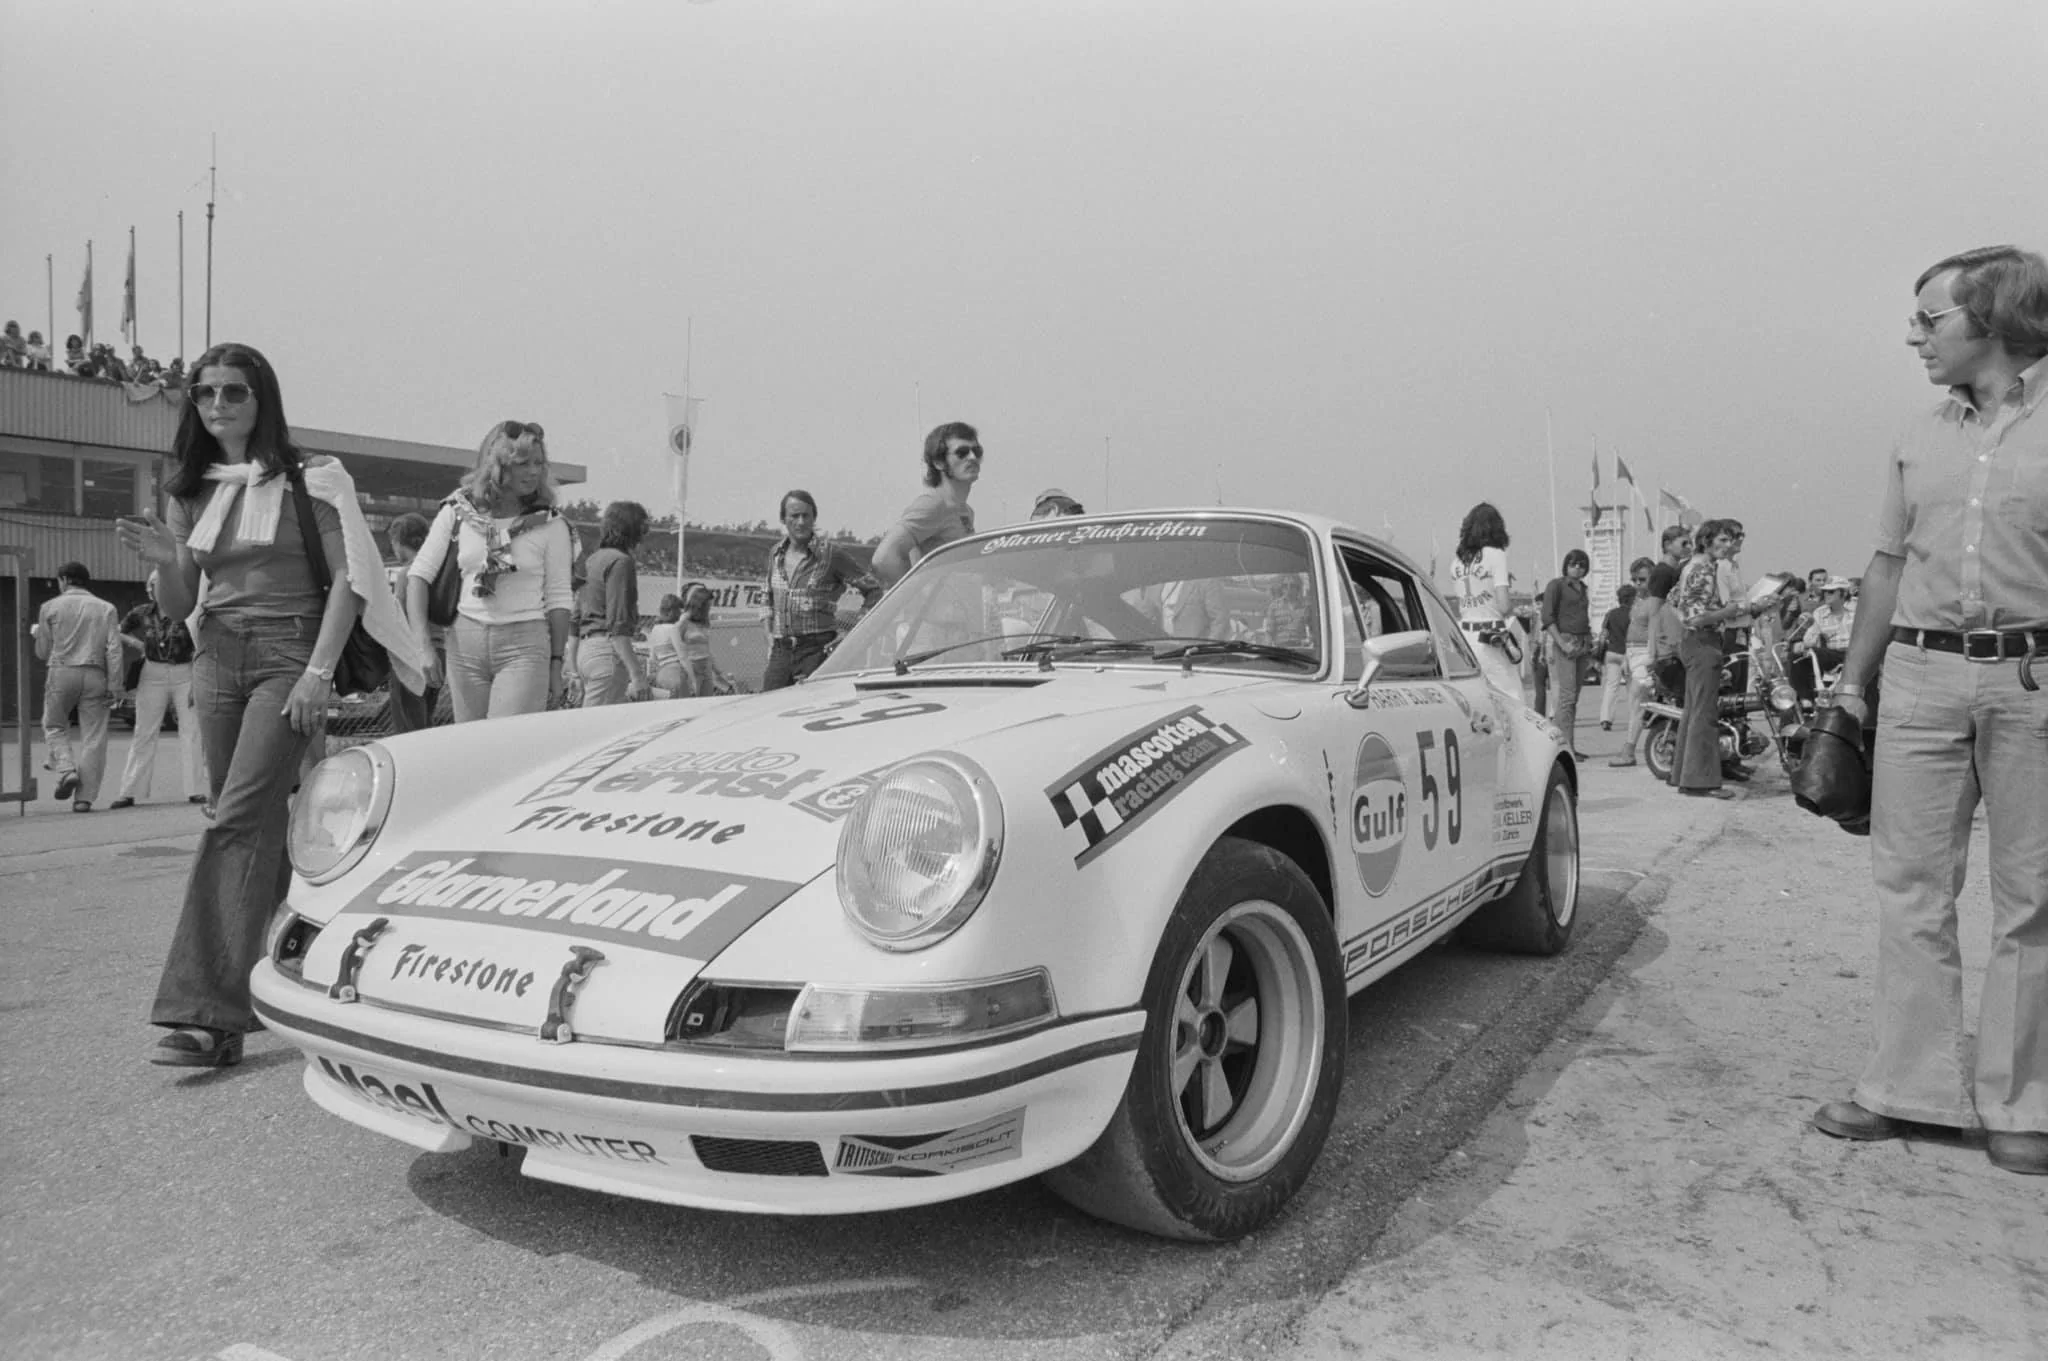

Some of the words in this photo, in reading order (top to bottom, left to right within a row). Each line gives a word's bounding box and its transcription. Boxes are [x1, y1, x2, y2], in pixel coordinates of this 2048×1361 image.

[980, 530, 1070, 554] Glarner
[1068, 520, 1208, 544] Nachrichten
[711, 584, 740, 607] nti
[592, 769, 825, 801] ernst
[632, 746, 800, 773] auto
[1114, 760, 1184, 817] racing
[1172, 738, 1218, 768] team
[1416, 725, 1462, 851] 59
[504, 805, 745, 844] Firestone
[1354, 793, 1405, 844] Gulf
[376, 857, 747, 942] Glarnerland
[1345, 879, 1476, 975] PORSCHE
[391, 943, 534, 998] Firestone
[465, 1114, 669, 1166] COMPUTER
